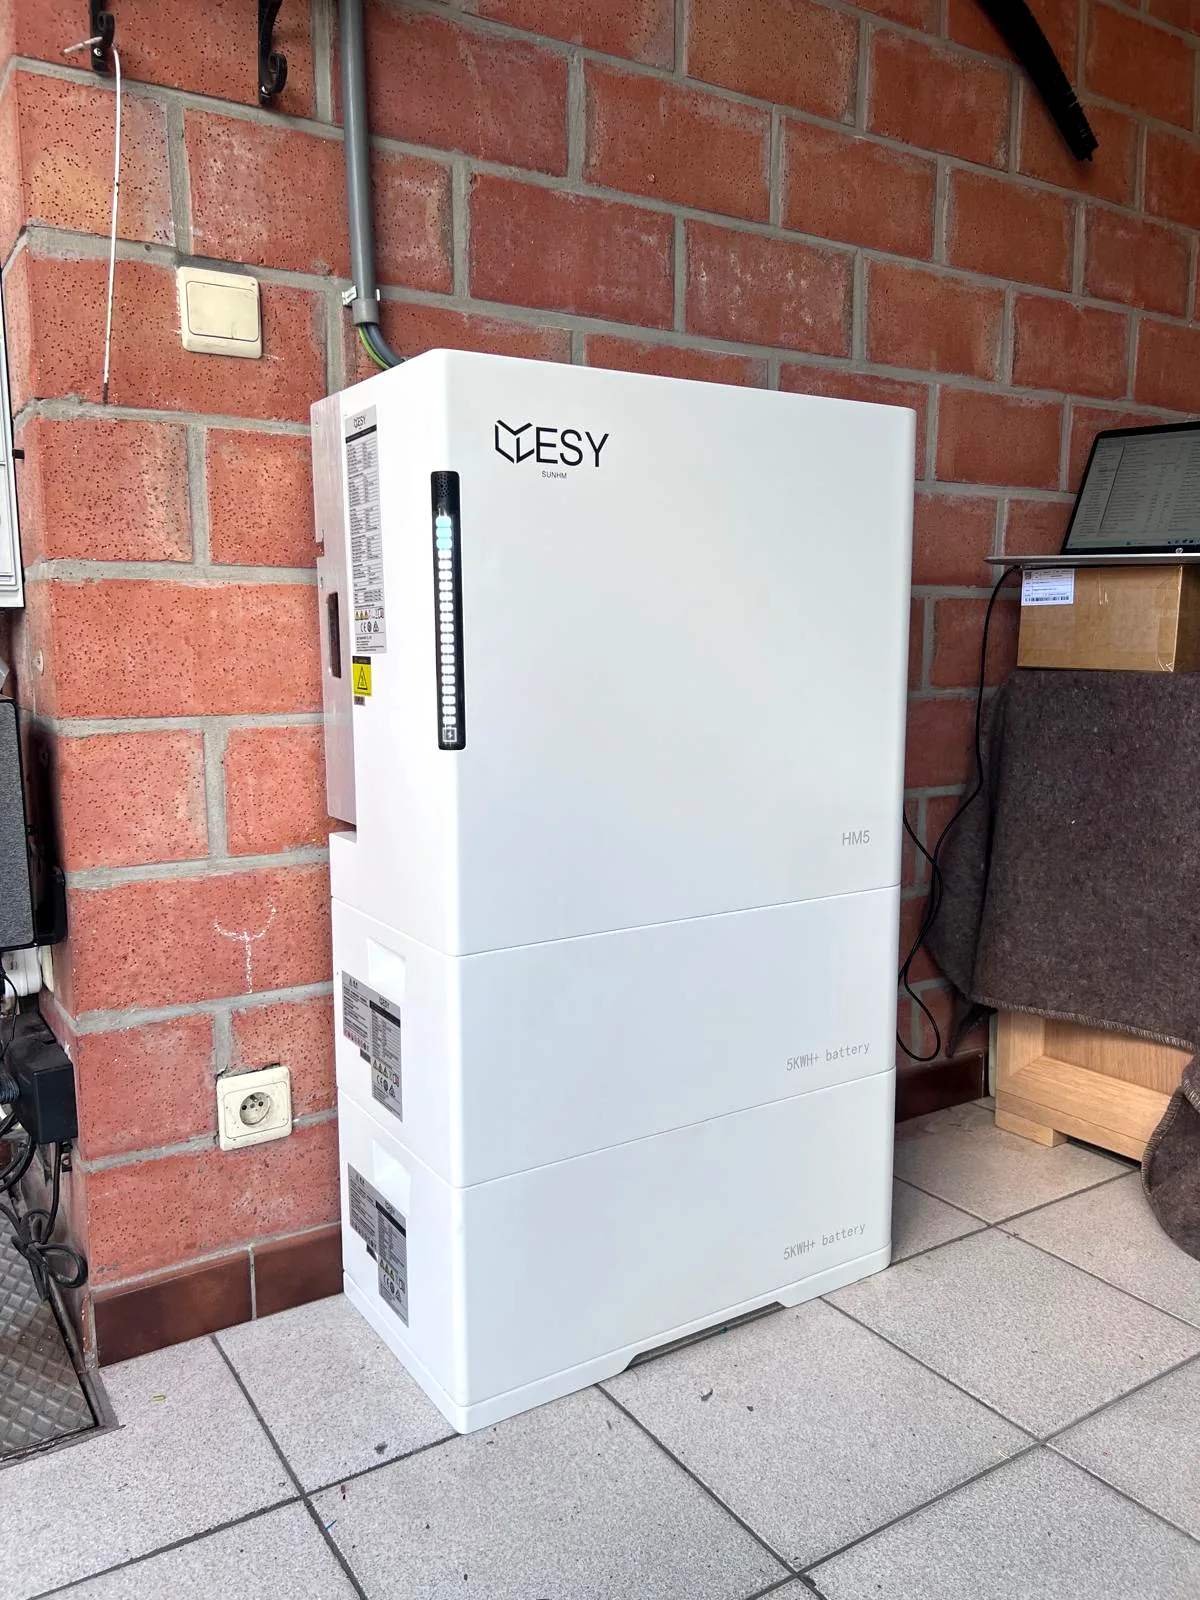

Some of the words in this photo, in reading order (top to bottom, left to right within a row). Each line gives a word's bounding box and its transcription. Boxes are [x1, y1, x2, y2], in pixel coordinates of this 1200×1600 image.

[541, 470, 567, 479] SUNHM
[842, 829, 870, 846] HM5
[786, 1052, 820, 1071] 5KWH+
[825, 1042, 870, 1062] battery
[783, 1239, 816, 1260] 5KWH+
[822, 1223, 866, 1246] battery
